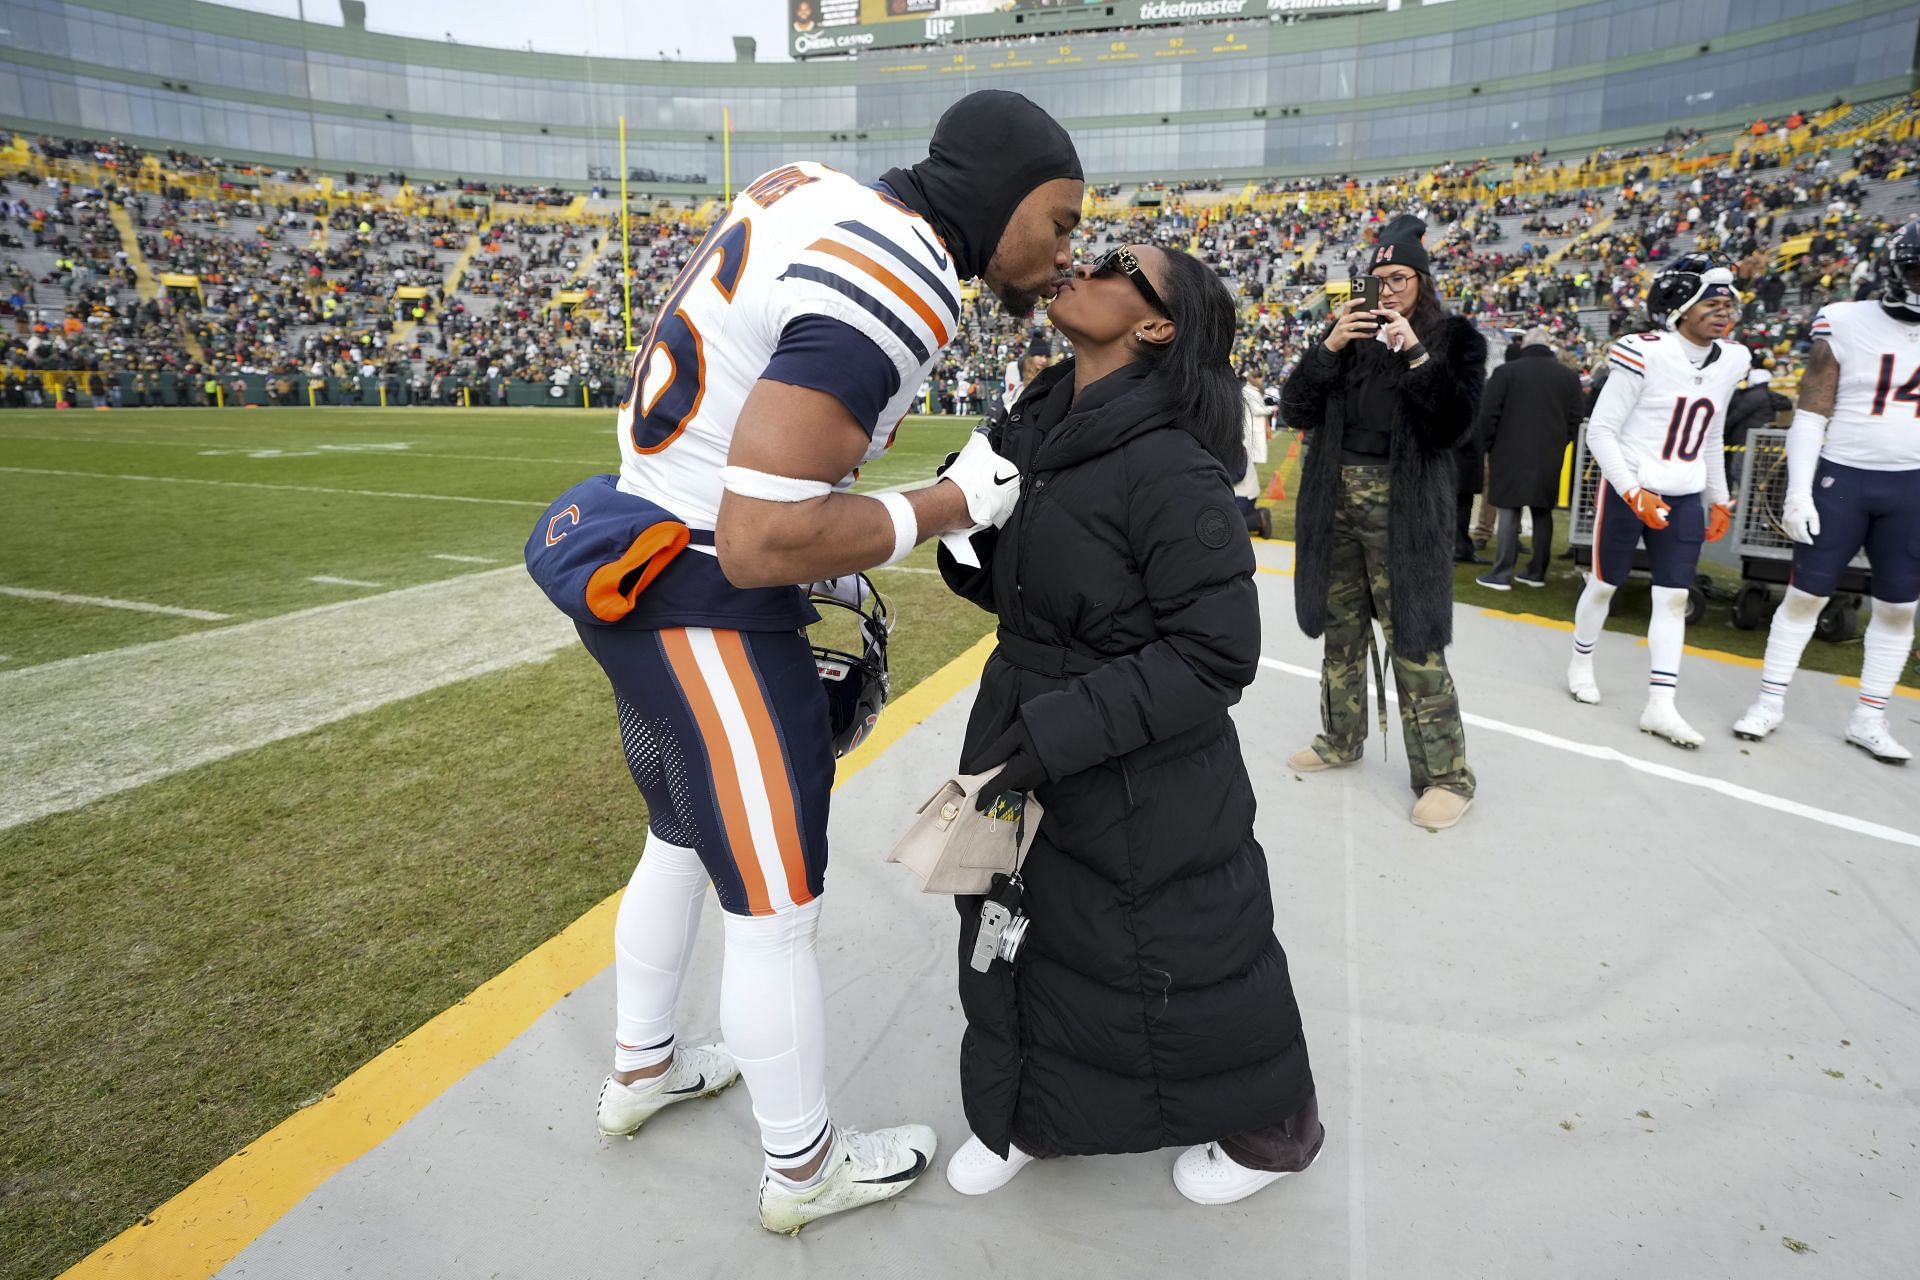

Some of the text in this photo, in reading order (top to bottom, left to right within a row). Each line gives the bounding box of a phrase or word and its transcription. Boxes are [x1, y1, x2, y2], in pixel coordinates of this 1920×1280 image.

[1140, 0, 1247, 20] ticketmaster
[924, 18, 956, 40] Lite
[1226, 33, 1234, 43] 4
[1871, 353, 1920, 418] 14
[1662, 396, 1715, 462] 10
